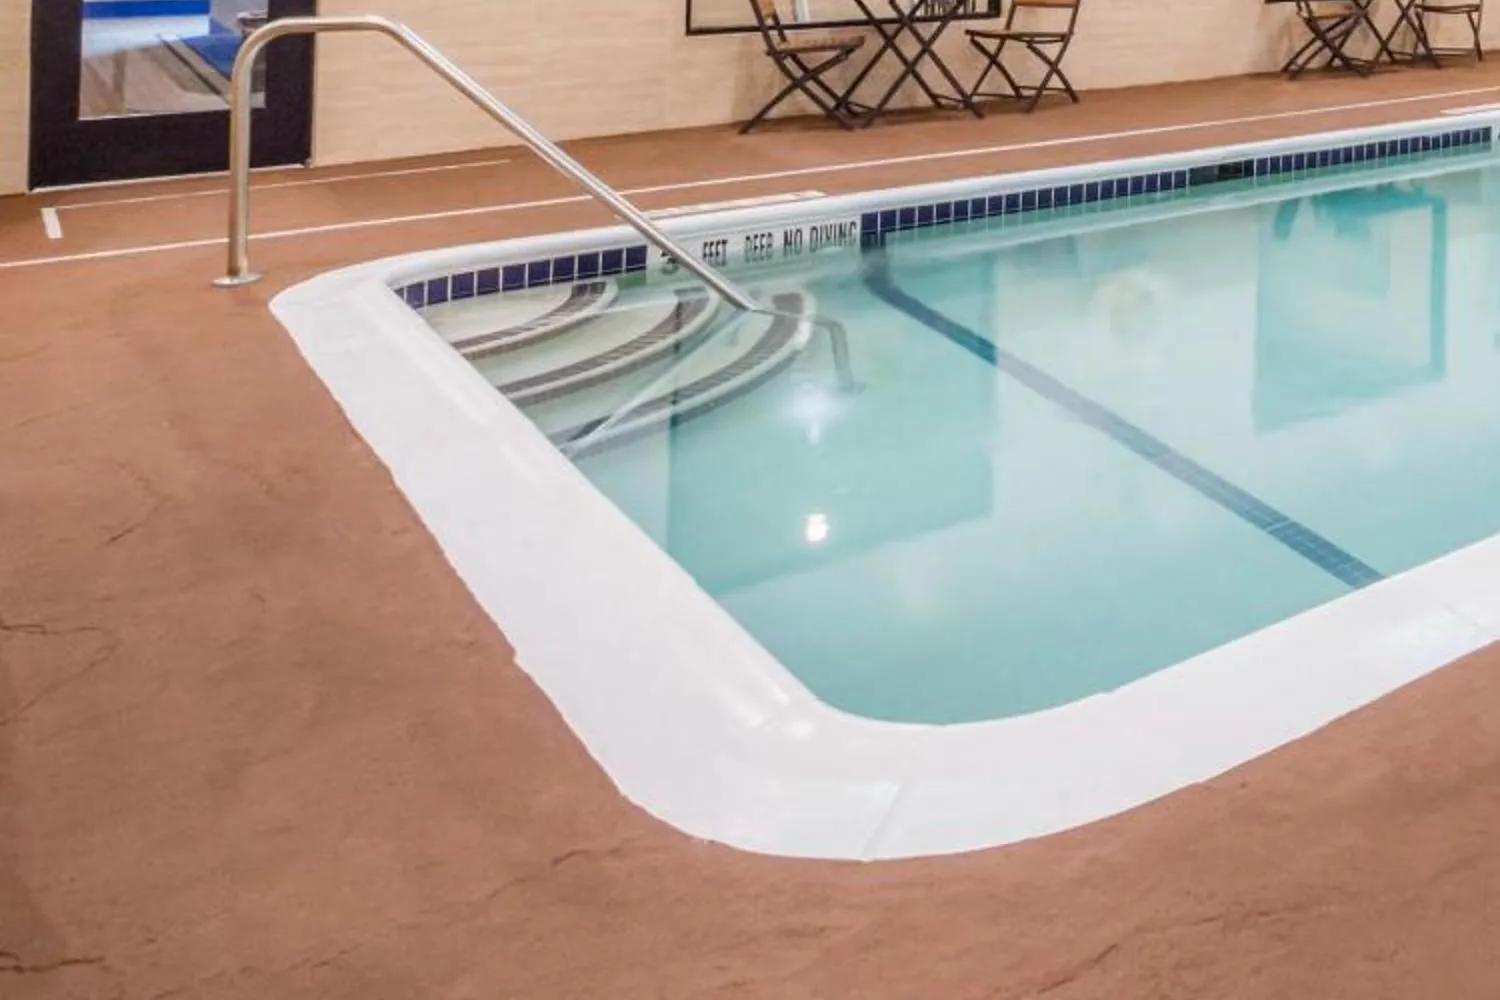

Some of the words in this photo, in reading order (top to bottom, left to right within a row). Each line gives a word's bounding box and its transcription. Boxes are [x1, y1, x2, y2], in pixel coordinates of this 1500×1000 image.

[702, 238, 729, 266] FEET
[783, 227, 803, 257] NO
[809, 221, 857, 254] DIVING
